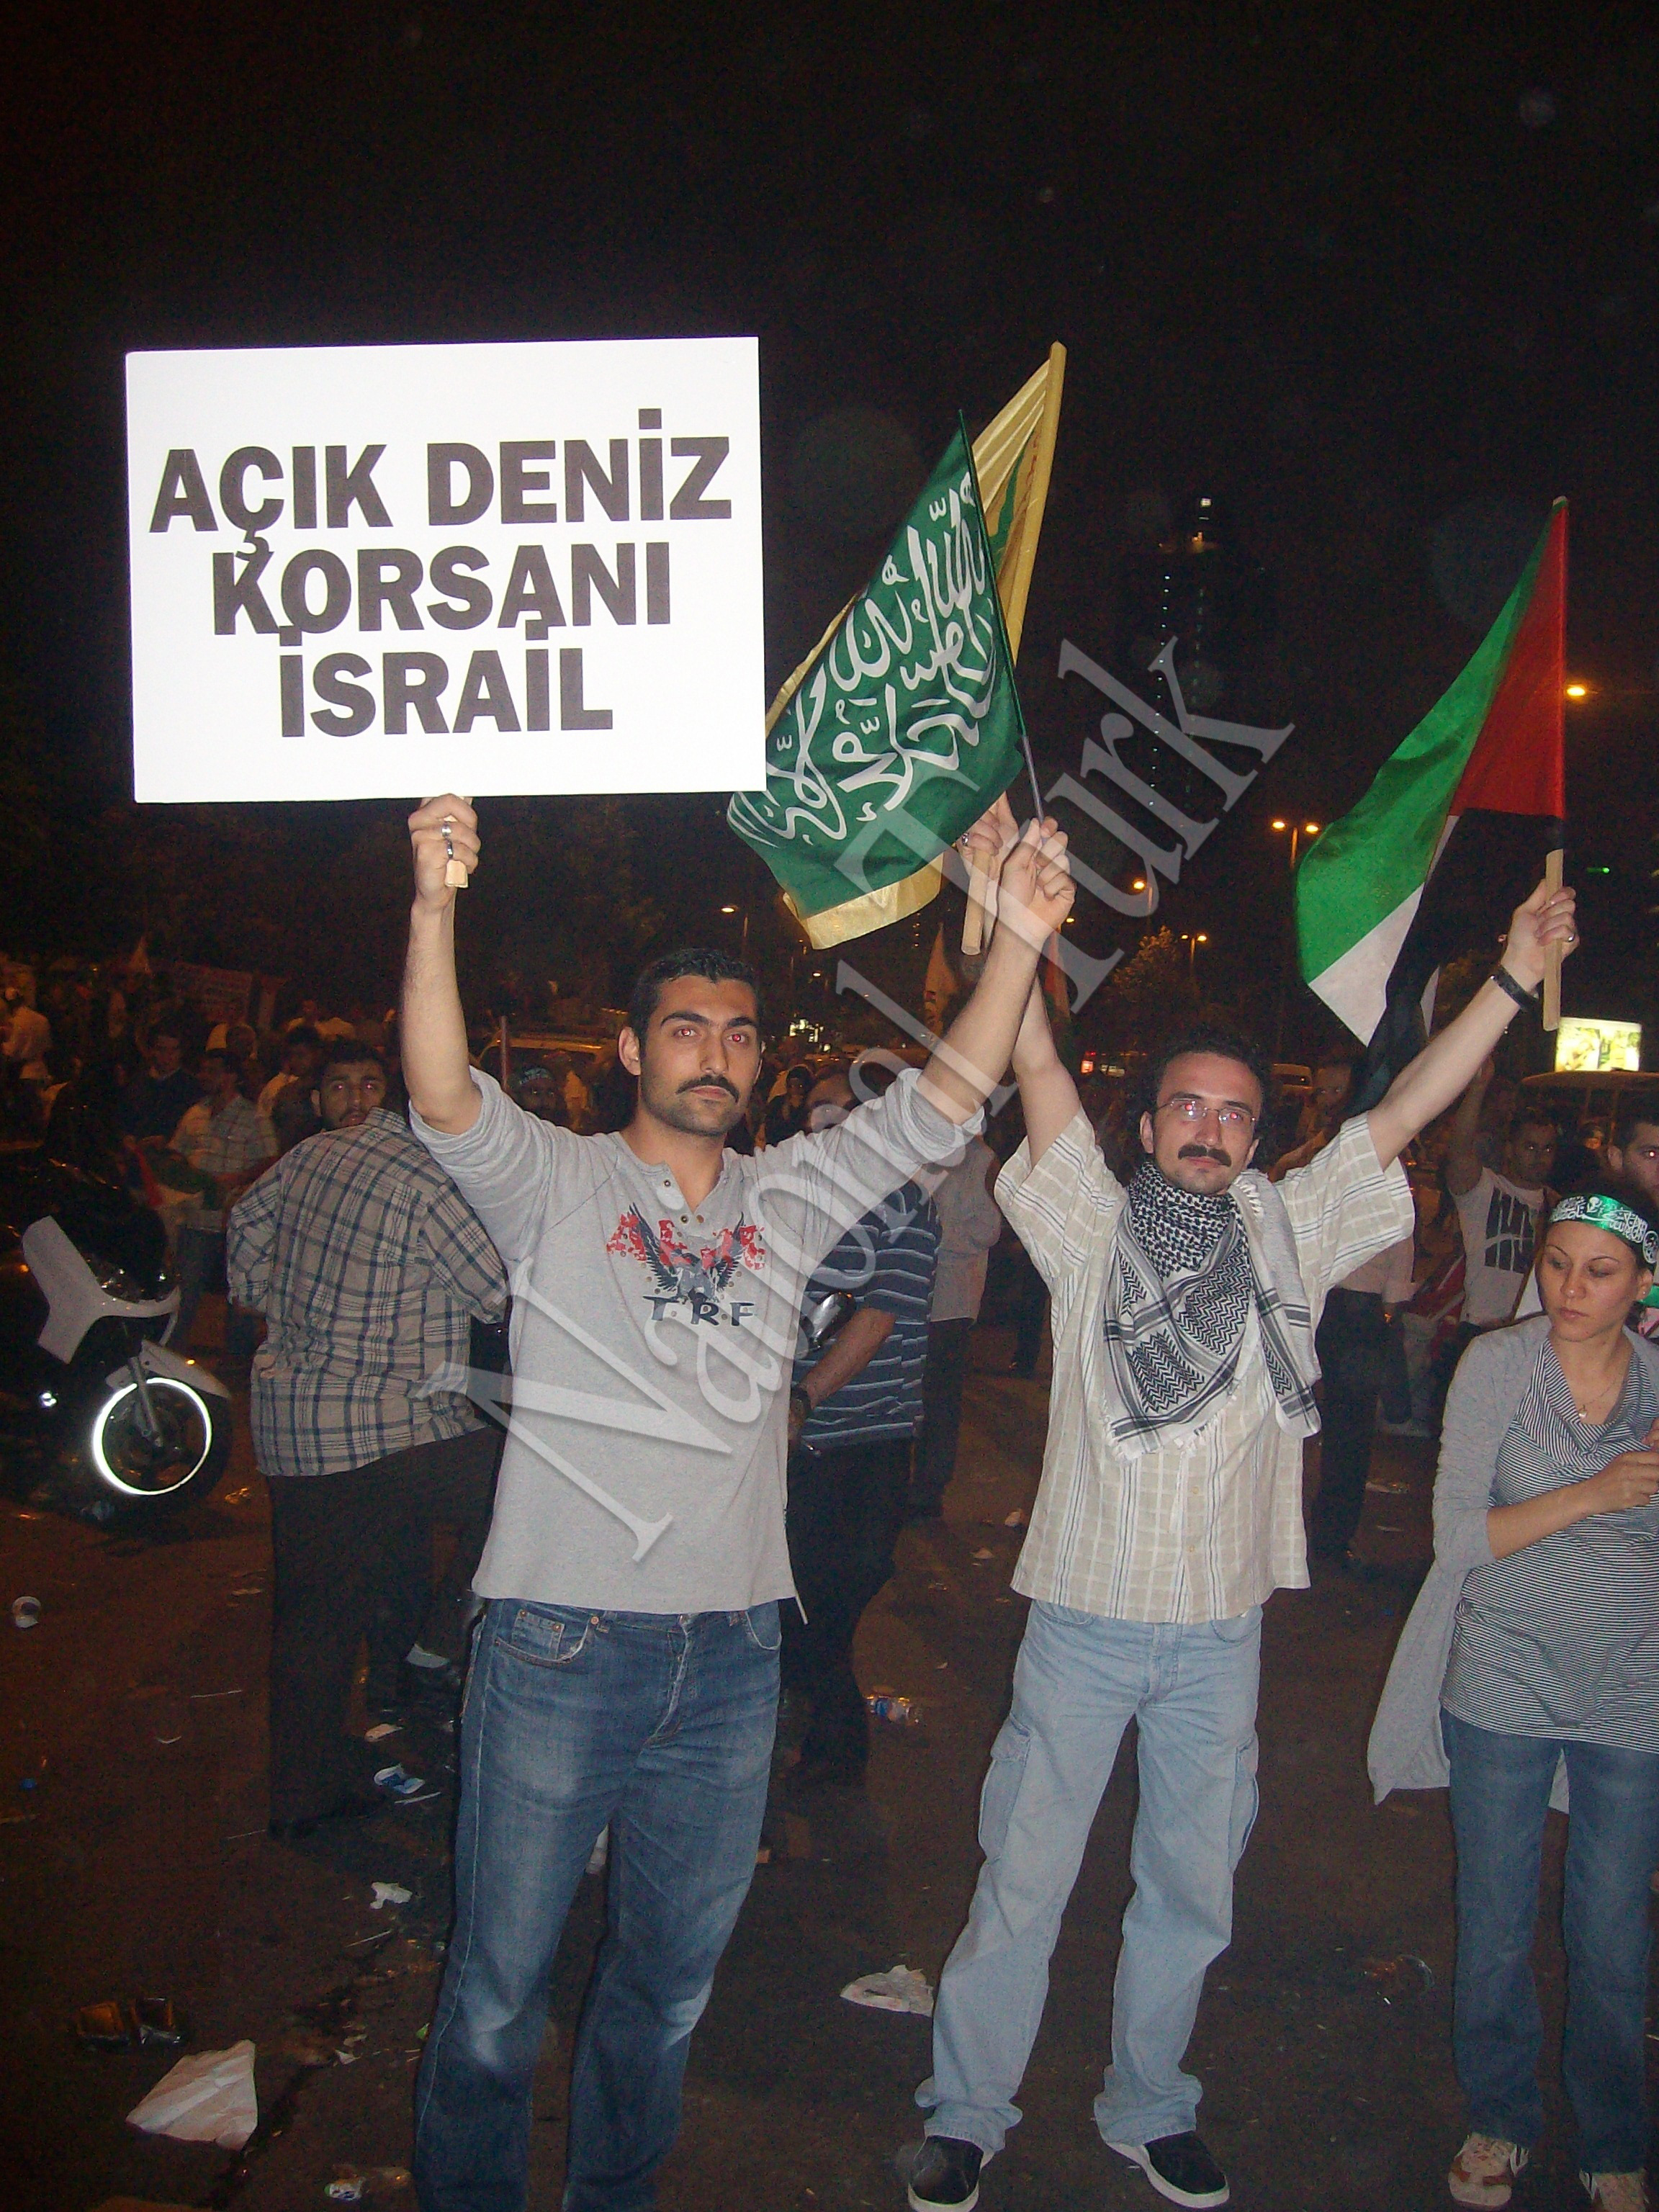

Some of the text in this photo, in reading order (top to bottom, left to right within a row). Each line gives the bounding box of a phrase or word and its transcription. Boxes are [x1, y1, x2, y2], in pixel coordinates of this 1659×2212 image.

[148, 408, 732, 562] AÇIK DENİZ
[212, 541, 672, 635] KORSANI
[278, 619, 613, 738] İSRAİL
